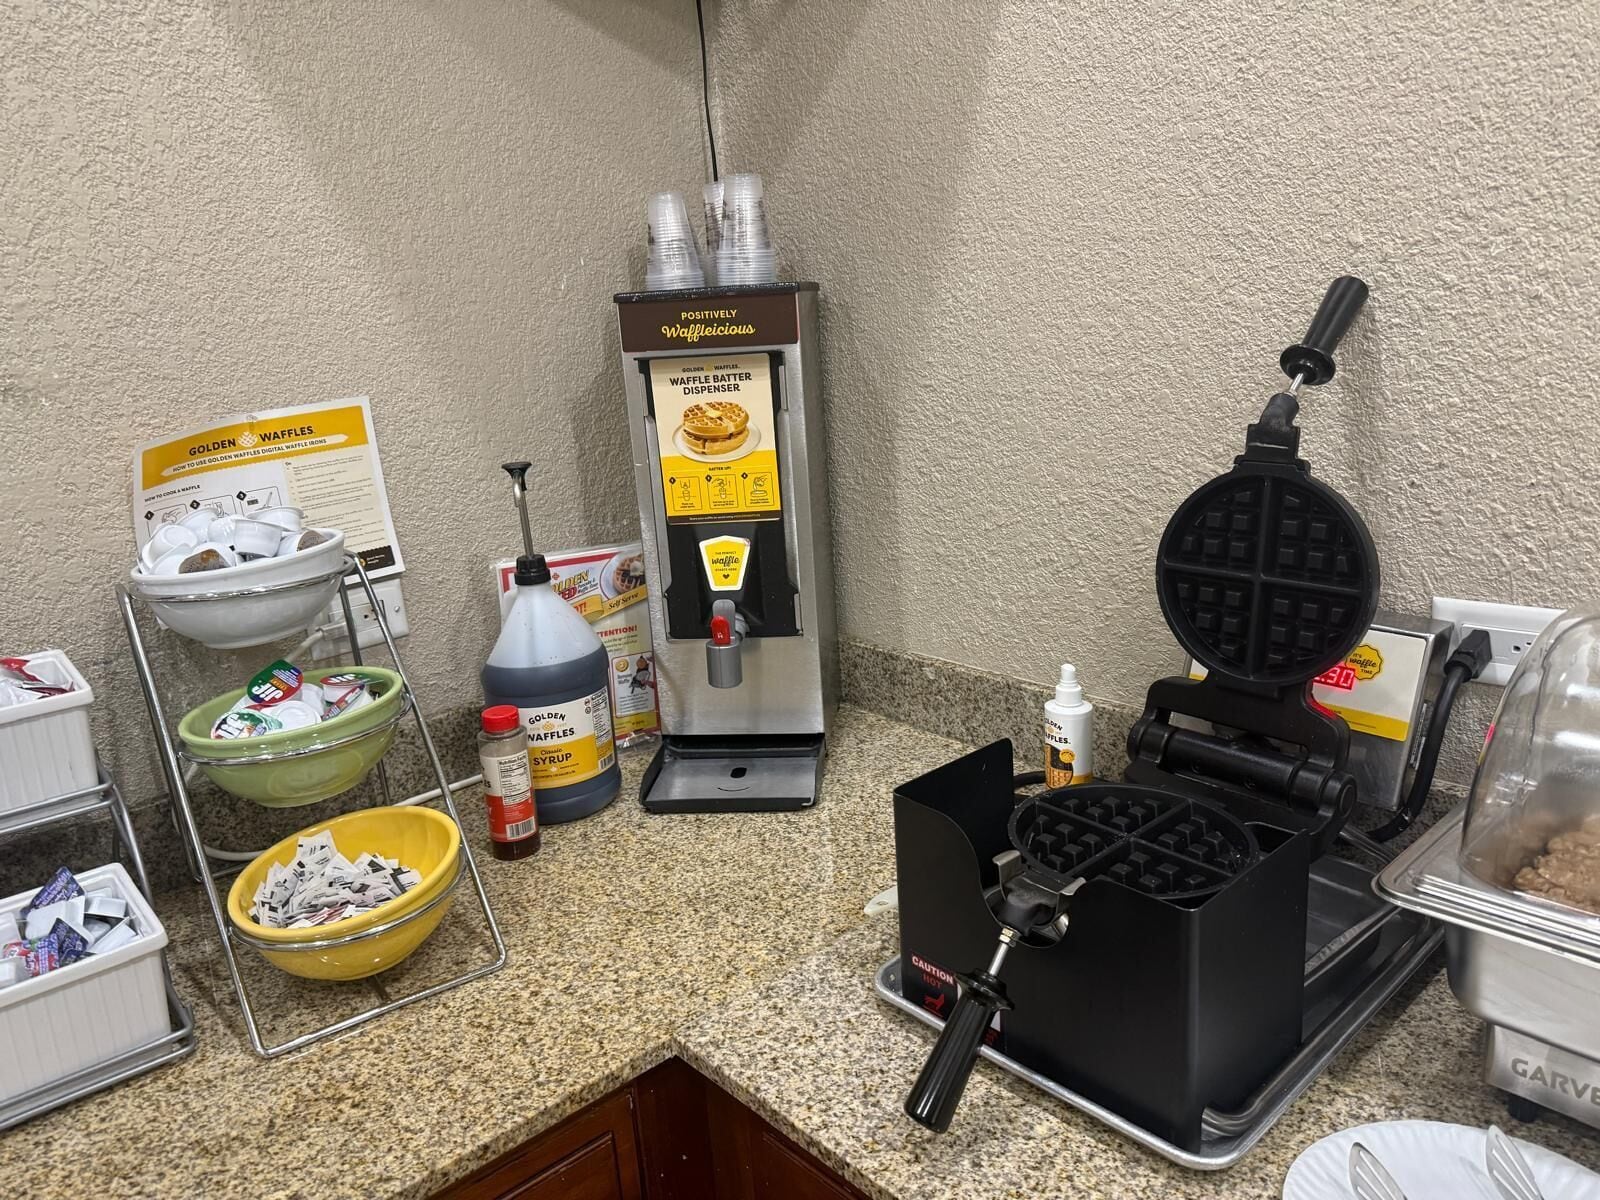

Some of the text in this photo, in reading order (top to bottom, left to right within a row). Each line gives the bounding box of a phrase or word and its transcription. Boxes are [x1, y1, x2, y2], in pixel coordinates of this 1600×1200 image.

[681, 309, 737, 320] POSITIVELY
[661, 322, 756, 342] Waffleicious
[669, 372, 752, 386] WAFFLE BATTER
[683, 383, 741, 395] DISPENSER
[188, 426, 314, 456] GOLDEN WAFFLES
[172, 438, 327, 473] HOW TO USE GOLDEN WAFFLES DIGITAL WAFFLE IRONS
[163, 489, 177, 497] COOK
[711, 556, 740, 567] waffle
[552, 570, 589, 593] OLDEN
[608, 592, 639, 610] Self Serve
[1349, 658, 1377, 669] waffle
[528, 712, 566, 725] GOLDEN
[1044, 717, 1063, 731] OLDEN
[540, 747, 563, 756] Classic
[533, 752, 572, 766] SYRUP
[911, 954, 954, 985] CAUTION
[923, 972, 943, 989] HOT
